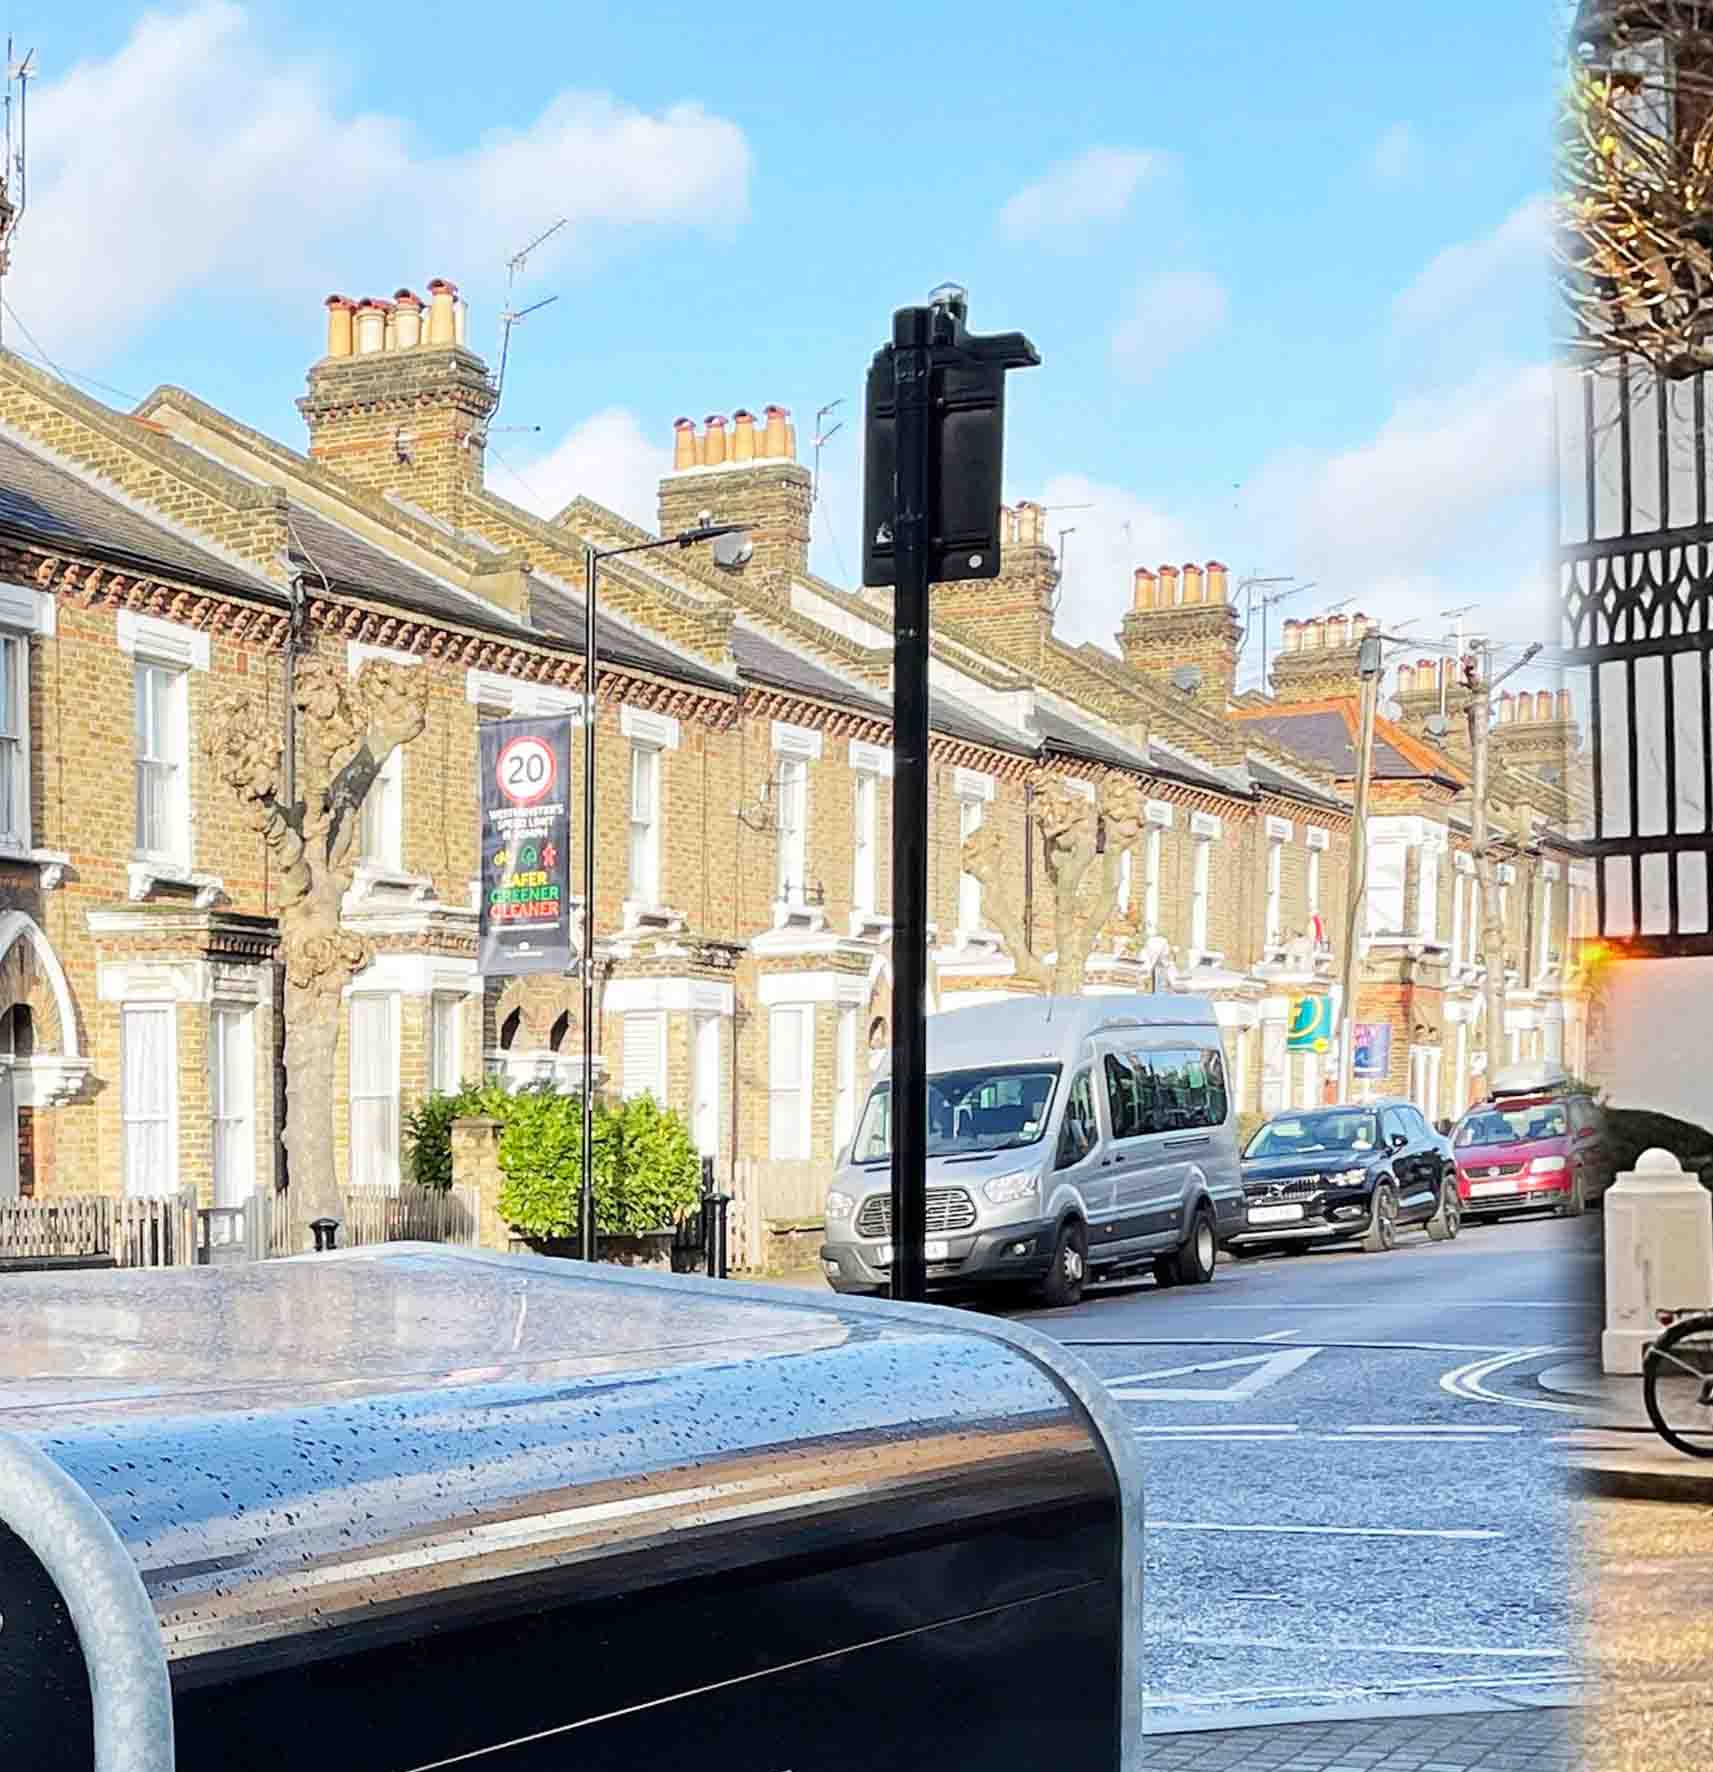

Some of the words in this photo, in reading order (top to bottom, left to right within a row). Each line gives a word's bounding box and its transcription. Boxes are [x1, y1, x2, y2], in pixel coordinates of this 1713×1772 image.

[509, 753, 544, 784] 20
[503, 871, 547, 887] SAFER
[490, 886, 559, 903] GREENER
[490, 901, 559, 919] CLEANER
